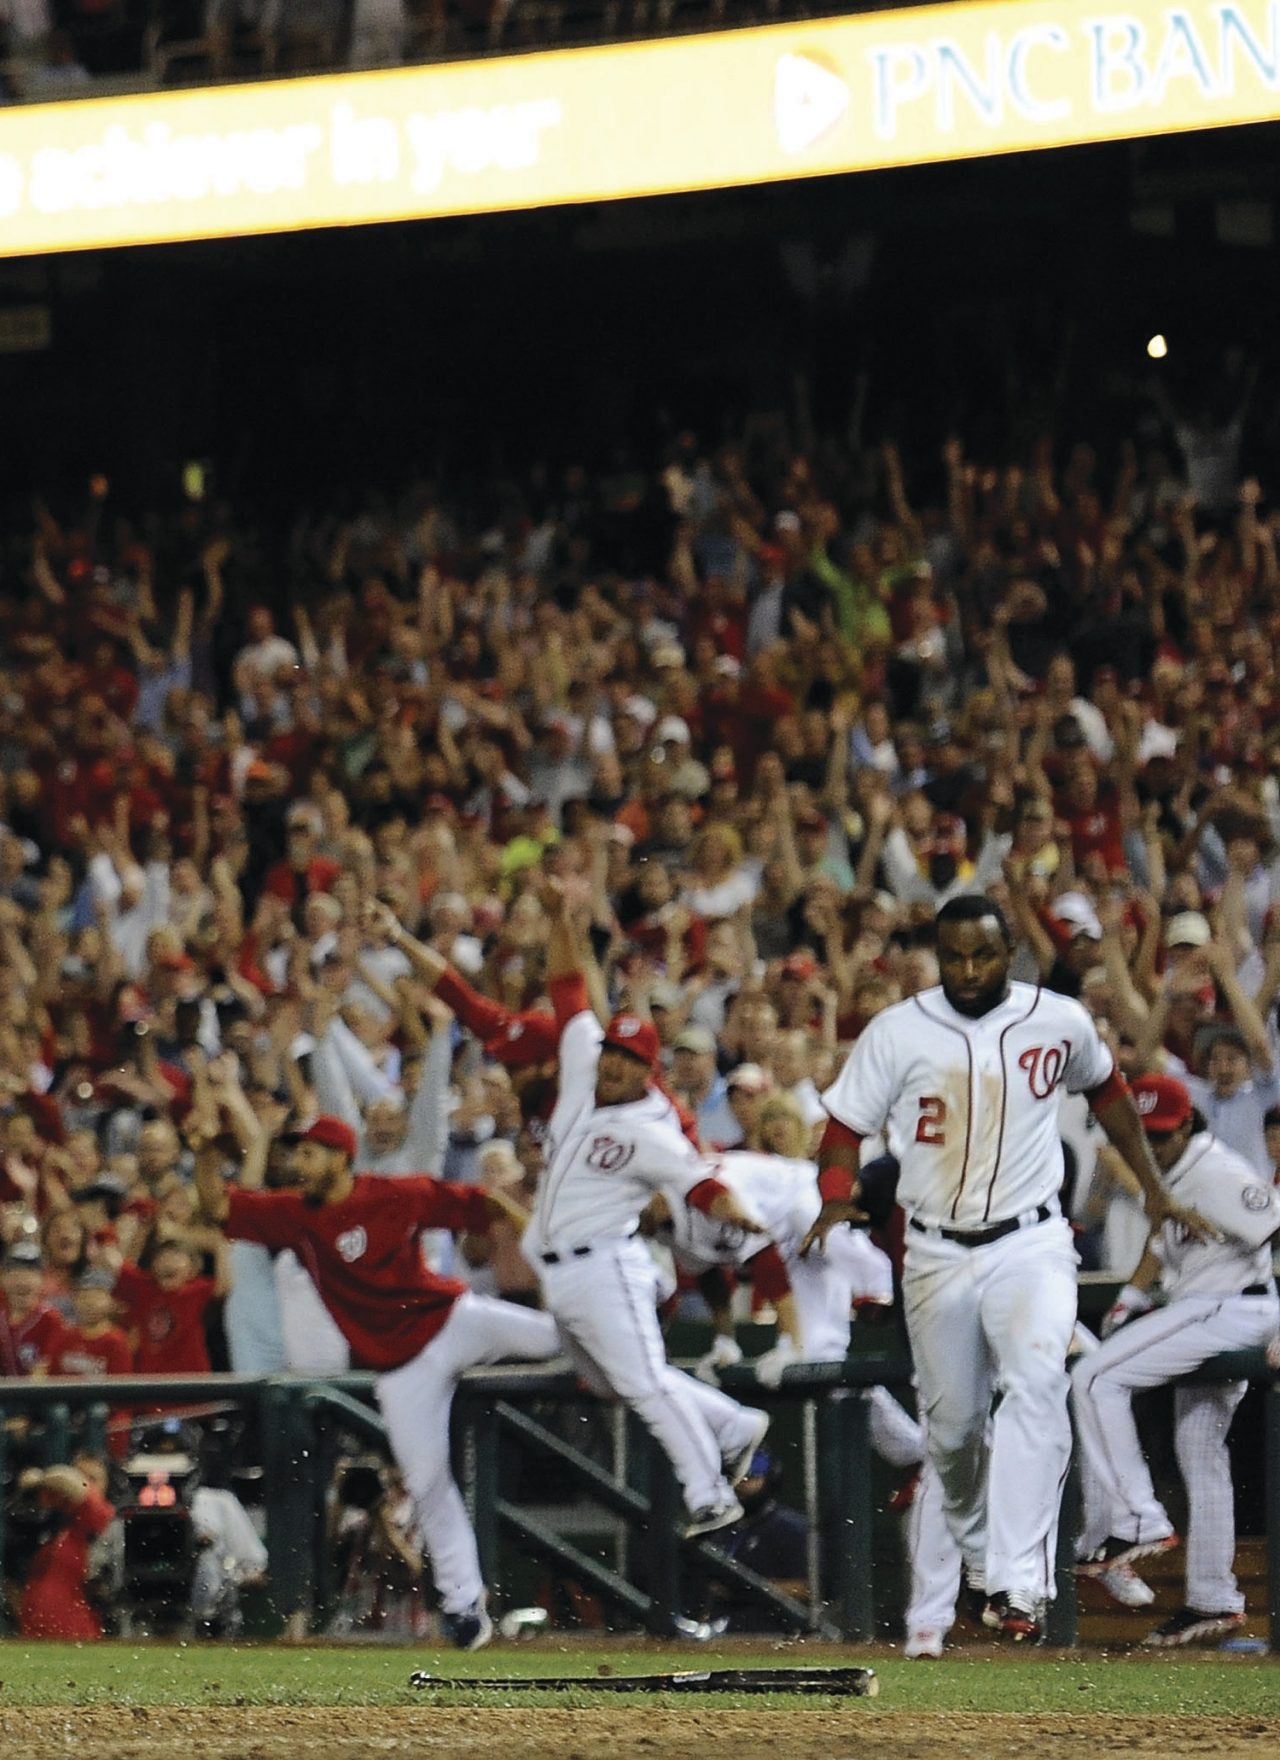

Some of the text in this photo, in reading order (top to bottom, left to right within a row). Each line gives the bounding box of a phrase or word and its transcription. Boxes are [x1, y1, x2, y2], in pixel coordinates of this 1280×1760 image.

[864, 21, 1072, 141] PNC
[29, 121, 321, 214] achiever
[330, 100, 400, 187] in
[407, 98, 562, 193] your
[1018, 1038, 1072, 1100] W
[915, 1096, 947, 1145] 2
